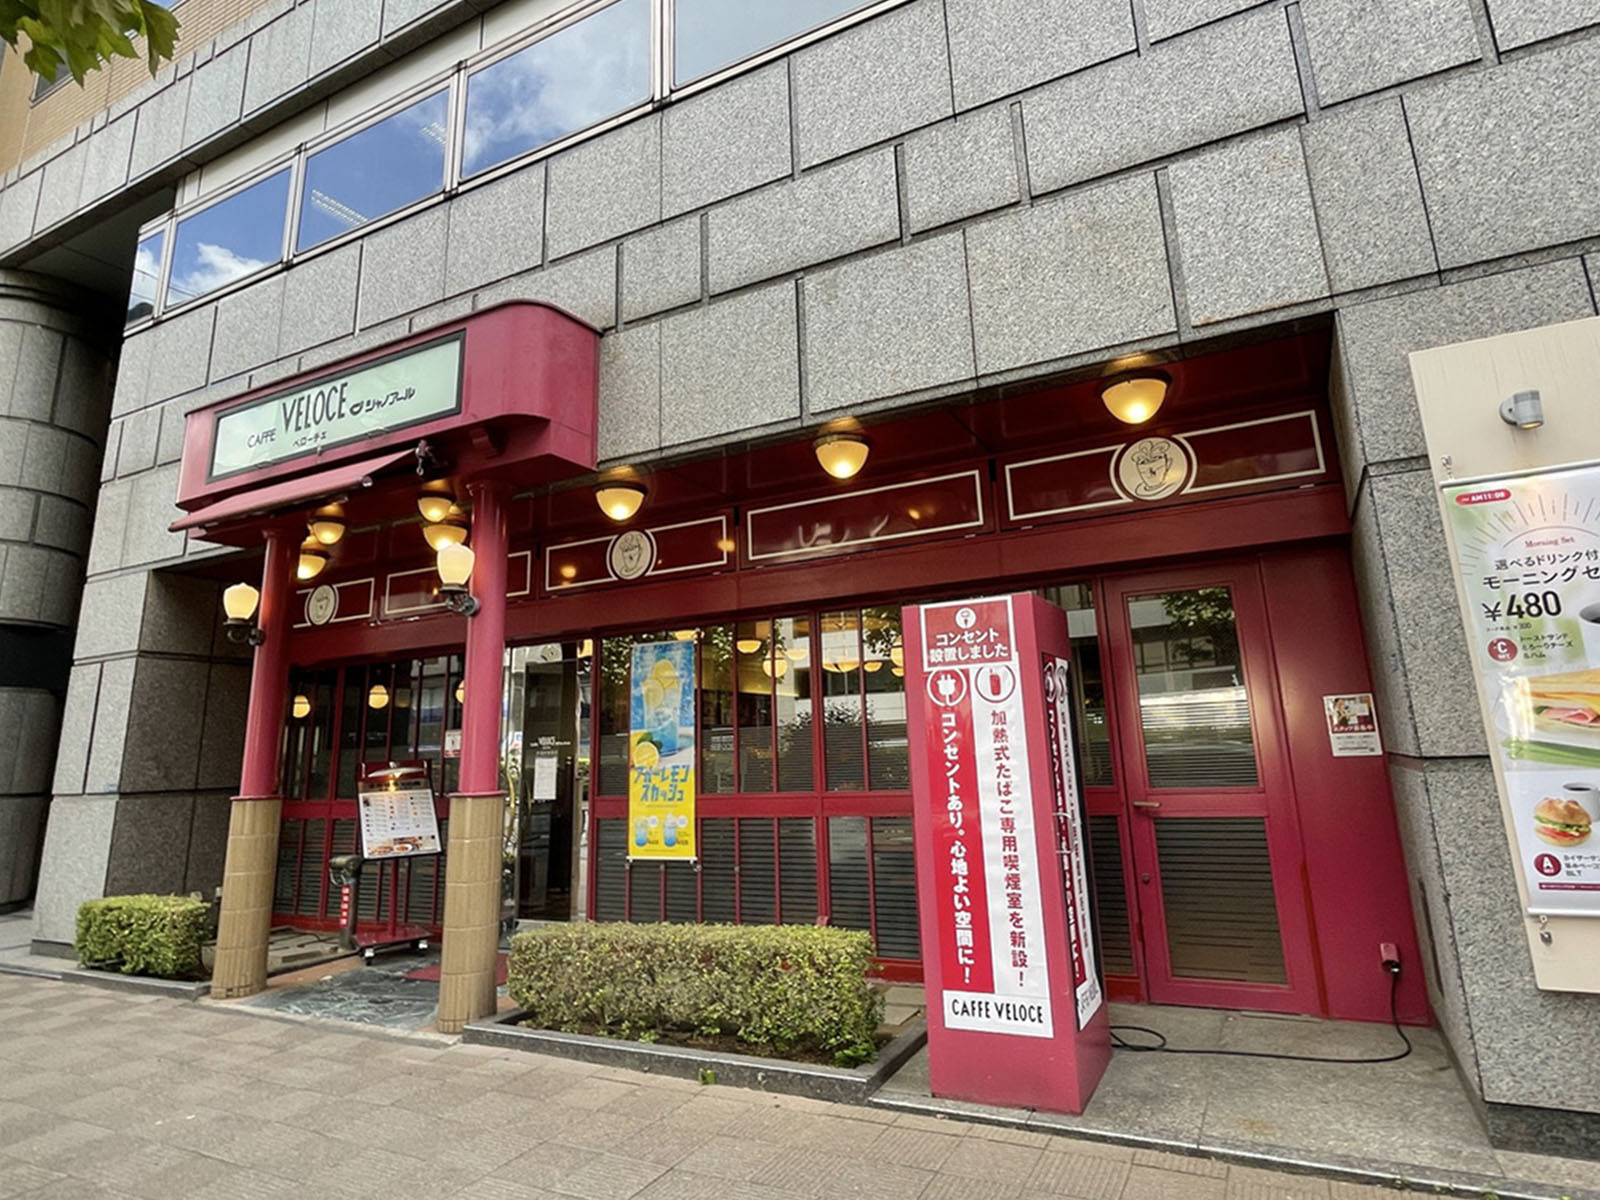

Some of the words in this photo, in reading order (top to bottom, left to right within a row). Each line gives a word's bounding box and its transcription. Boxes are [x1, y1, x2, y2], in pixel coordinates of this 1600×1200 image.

[247, 428, 277, 448] CAFFE
[281, 382, 349, 433] VELOCE
[1525, 539, 1559, 549] Morning
[1481, 590, 1562, 622] ¥480
[935, 627, 1000, 647] コンセント
[929, 643, 1009, 663] 設置しました
[1497, 641, 1508, 655] C
[1543, 856, 1554, 869] A
[951, 999, 991, 1019] CAFFE
[994, 1002, 1044, 1024] VELOCE
